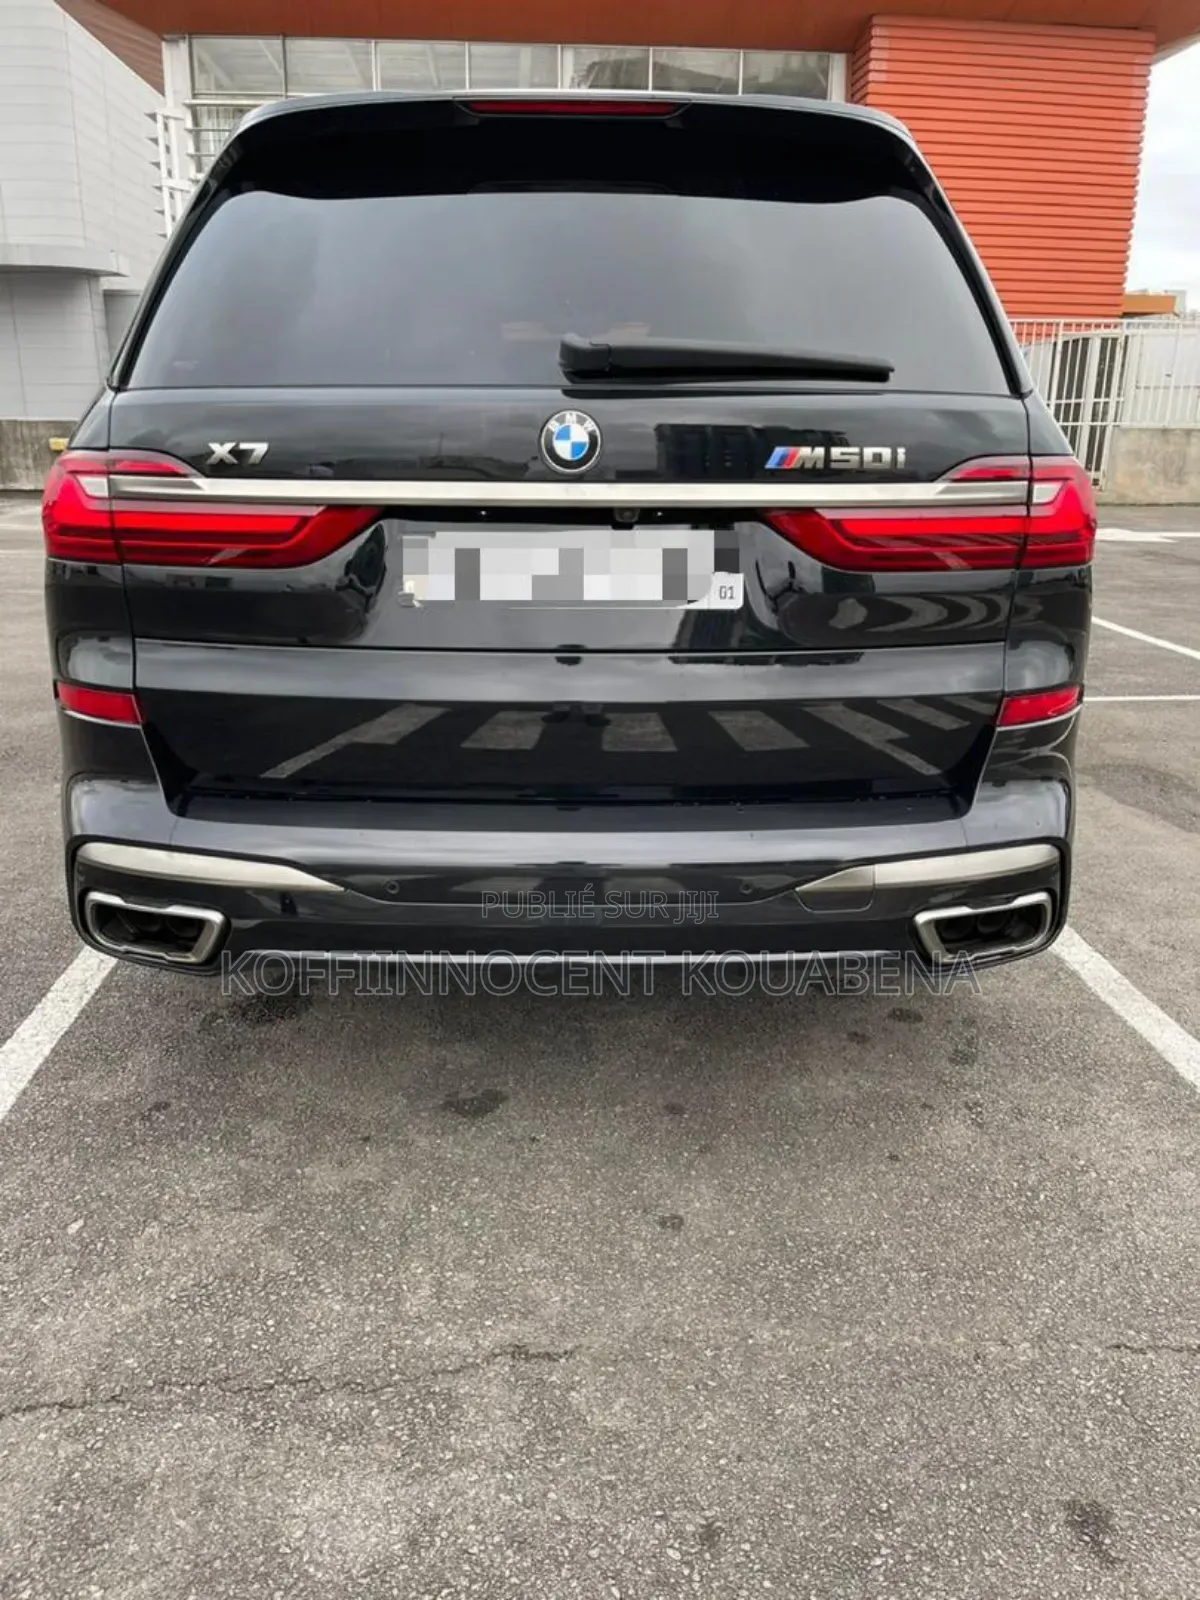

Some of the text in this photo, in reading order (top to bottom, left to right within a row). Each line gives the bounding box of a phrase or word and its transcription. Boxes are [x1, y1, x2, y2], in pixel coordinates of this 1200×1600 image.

[547, 412, 597, 433] BMW
[207, 441, 270, 465] X7
[792, 446, 906, 469] M50i
